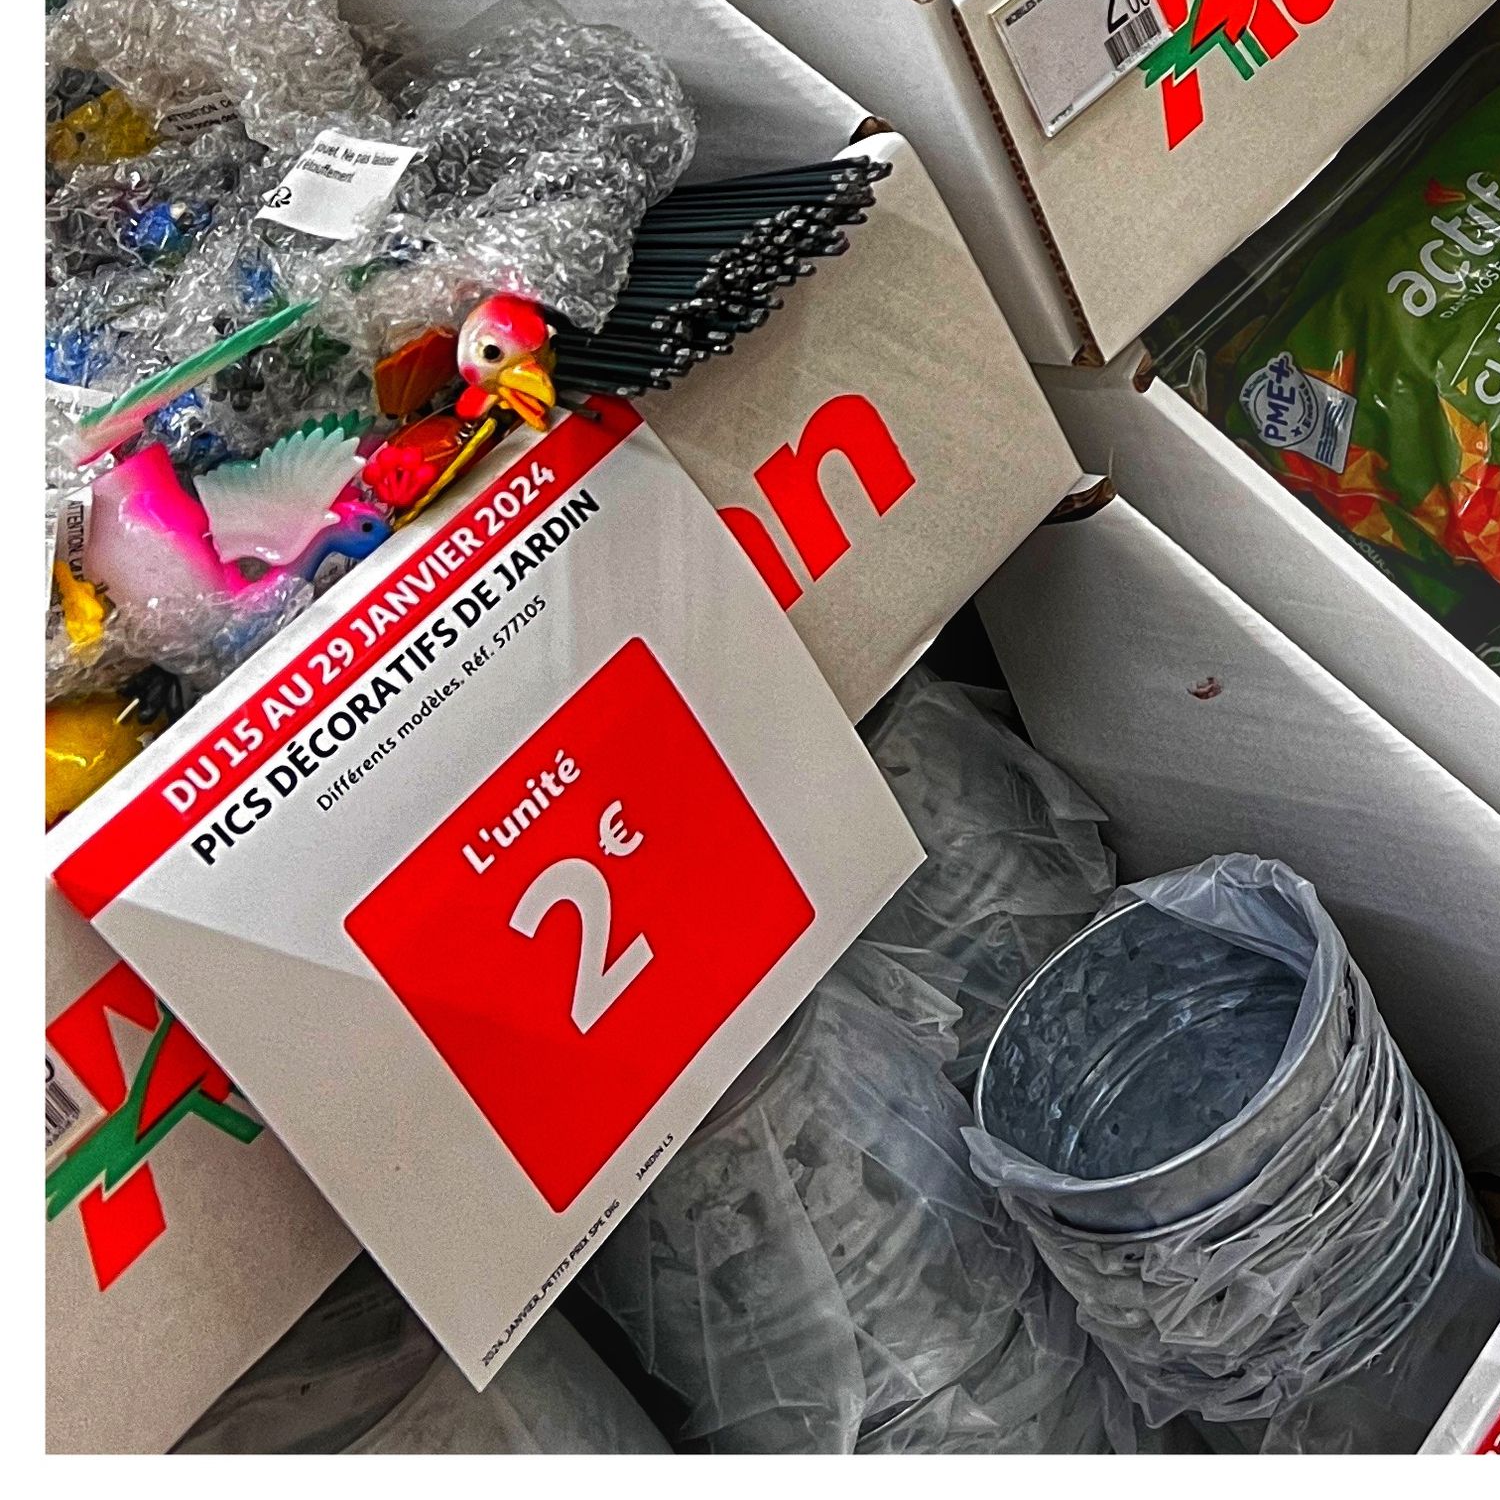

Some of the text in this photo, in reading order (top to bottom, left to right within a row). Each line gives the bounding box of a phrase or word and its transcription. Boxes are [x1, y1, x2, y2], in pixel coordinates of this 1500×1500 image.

[339, 148, 354, 164] Ne
[352, 150, 372, 167] pas
[1469, 268, 1499, 297] VOS
[160, 459, 558, 817] DU 15 AU 29 JANVIER 2024
[190, 487, 603, 867] PICS DÉCORATIFS DE JARDIN
[316, 593, 547, 812] Différents modèles. Réf. 577105
[461, 748, 582, 875] L'unité
[635, 1144, 665, 1182] JARDIN
